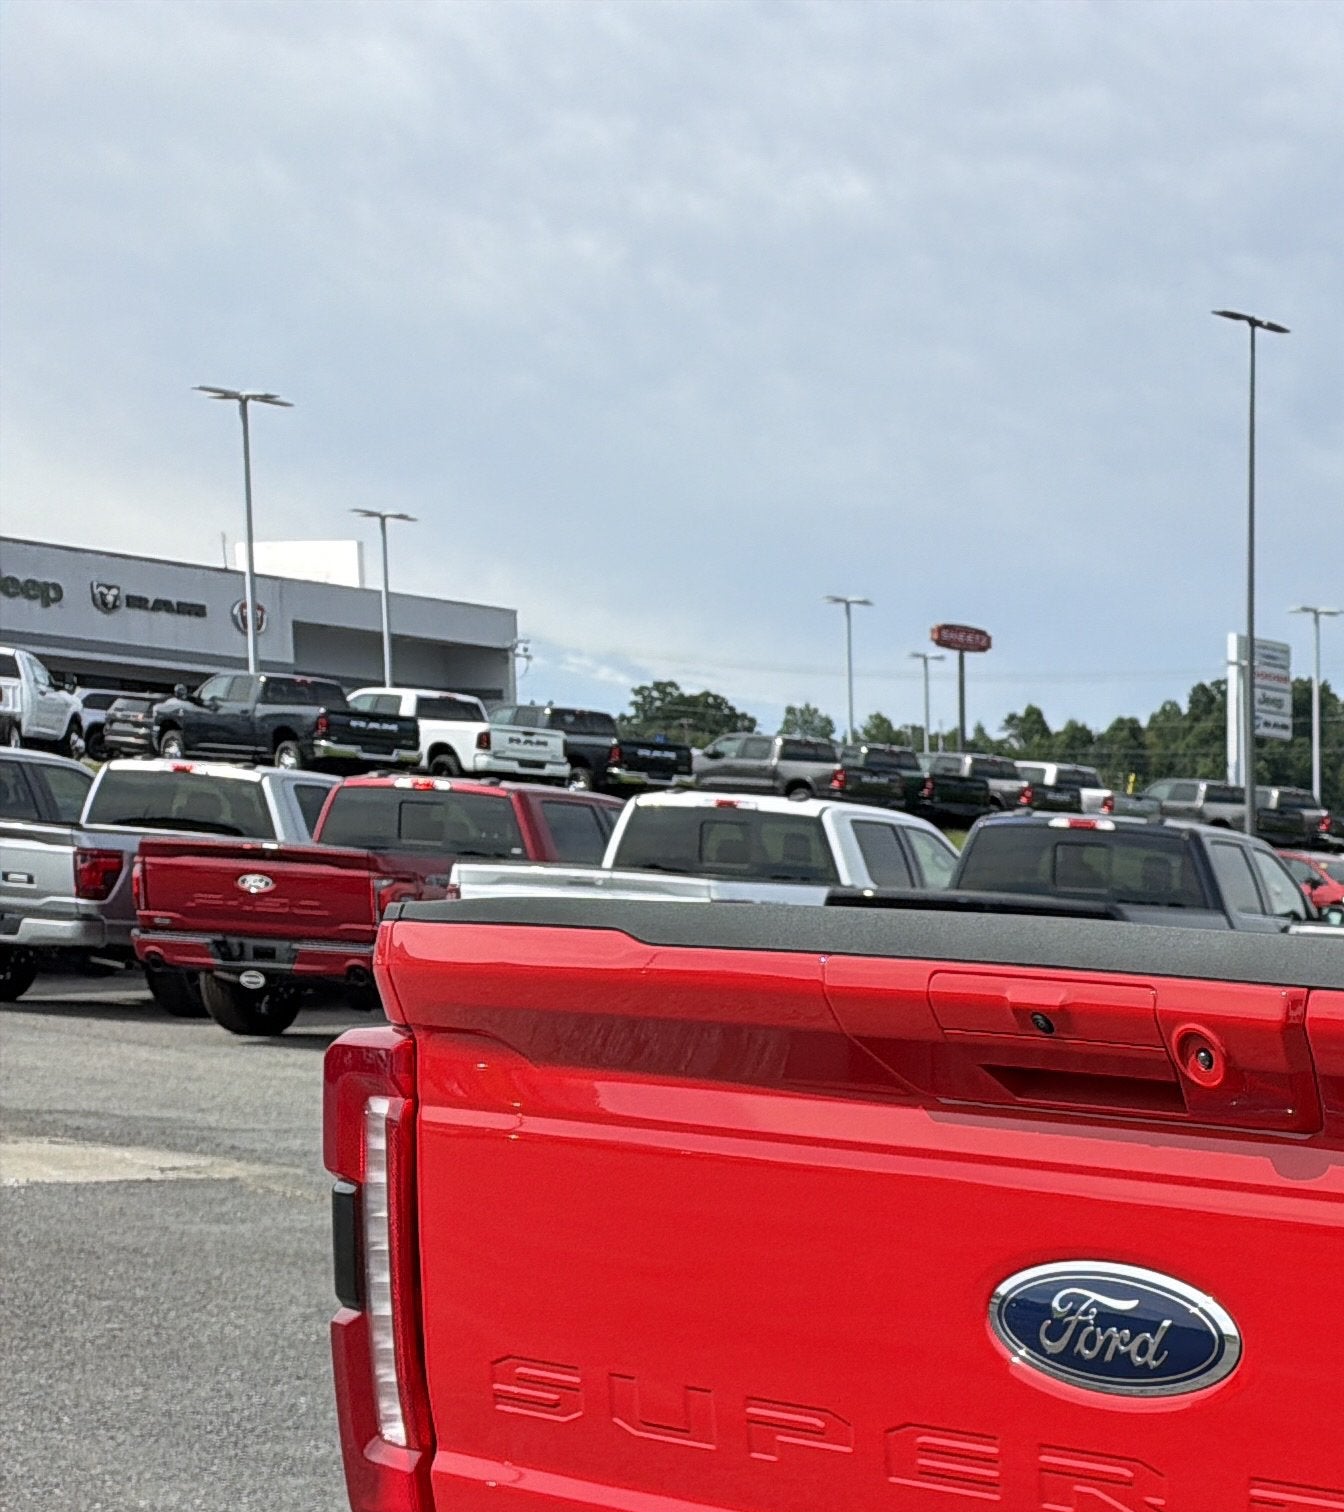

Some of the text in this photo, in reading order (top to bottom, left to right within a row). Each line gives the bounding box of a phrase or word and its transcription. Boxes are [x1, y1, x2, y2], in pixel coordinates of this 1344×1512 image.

[0, 575, 64, 609] eep
[125, 594, 207, 618] RAM
[1039, 1287, 1173, 1370] Ford
